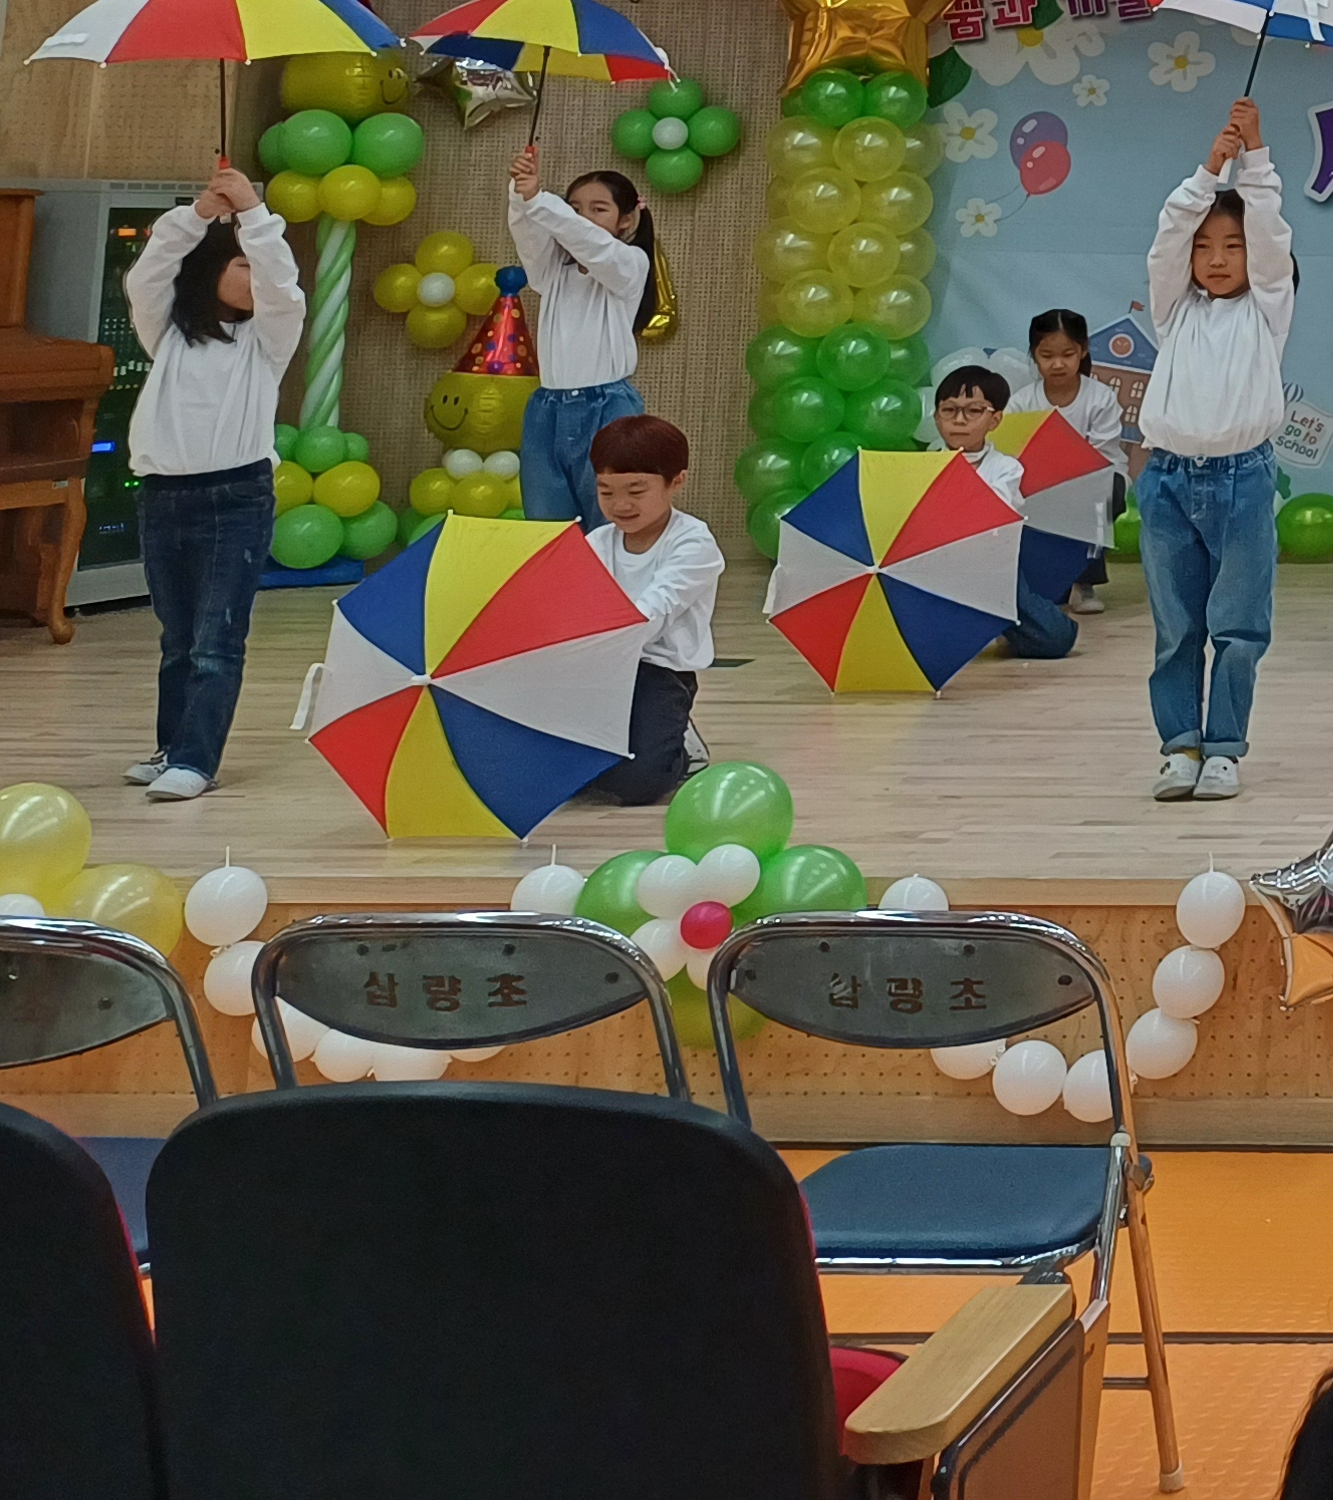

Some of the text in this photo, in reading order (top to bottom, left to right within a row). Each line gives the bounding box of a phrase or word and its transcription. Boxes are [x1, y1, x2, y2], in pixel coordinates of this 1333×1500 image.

[1290, 410, 1325, 433] Let's
[1284, 424, 1318, 445] go to
